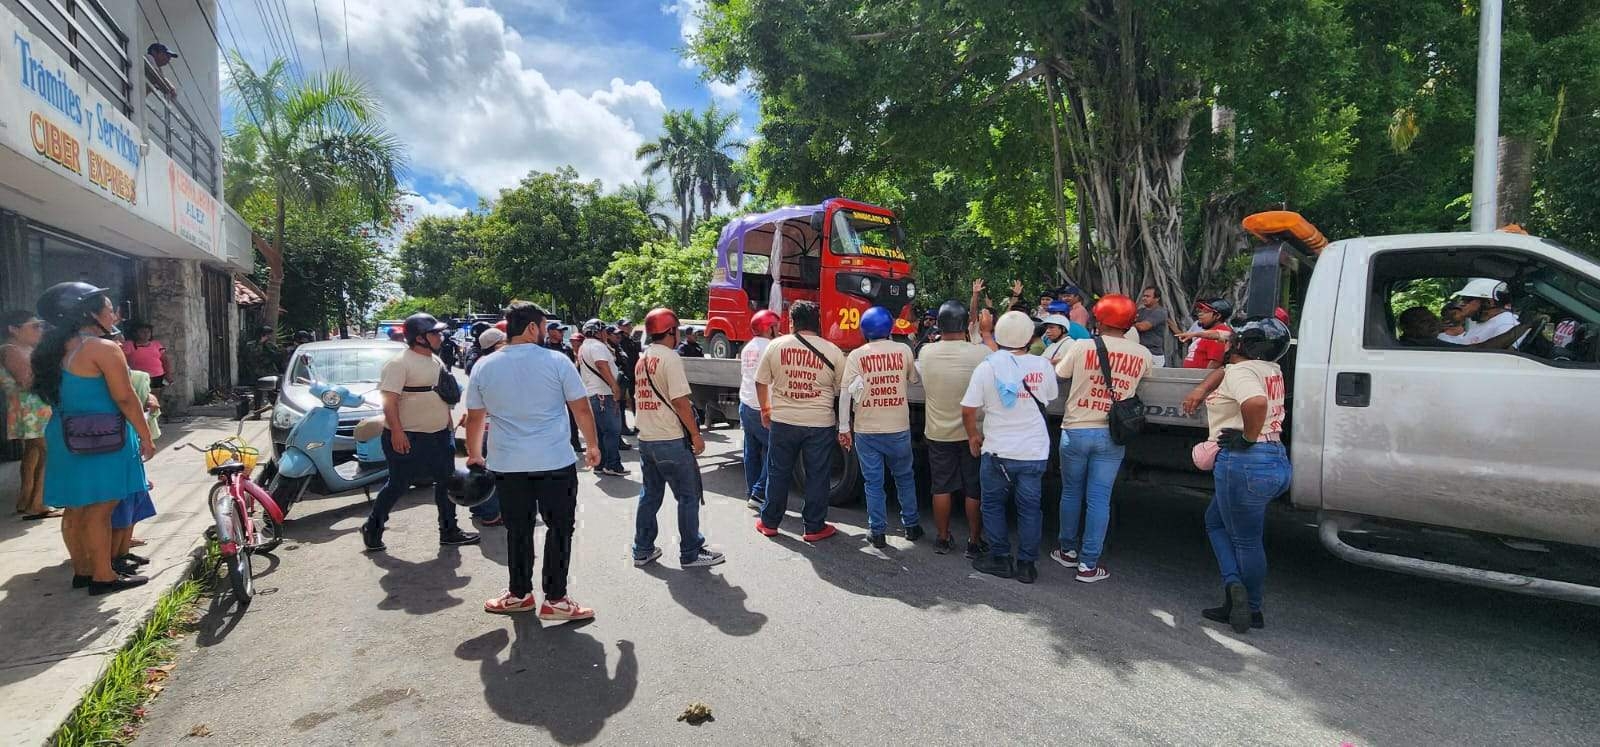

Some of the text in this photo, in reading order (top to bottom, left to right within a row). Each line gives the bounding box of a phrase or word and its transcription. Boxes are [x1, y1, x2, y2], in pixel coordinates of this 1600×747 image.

[86, 107, 93, 141] y
[97, 102, 140, 167] Servicios
[30, 110, 82, 176] CIBER
[87, 147, 137, 206] EXPRESS
[839, 308, 860, 330] 29
[860, 352, 904, 374] MOTOTAXIS
[1084, 349, 1144, 379] MOOTAXIS
[788, 381, 813, 391] SOMOS
[870, 386, 897, 396] SOMOS
[862, 399, 871, 408] LA
[1077, 398, 1089, 409] LA
